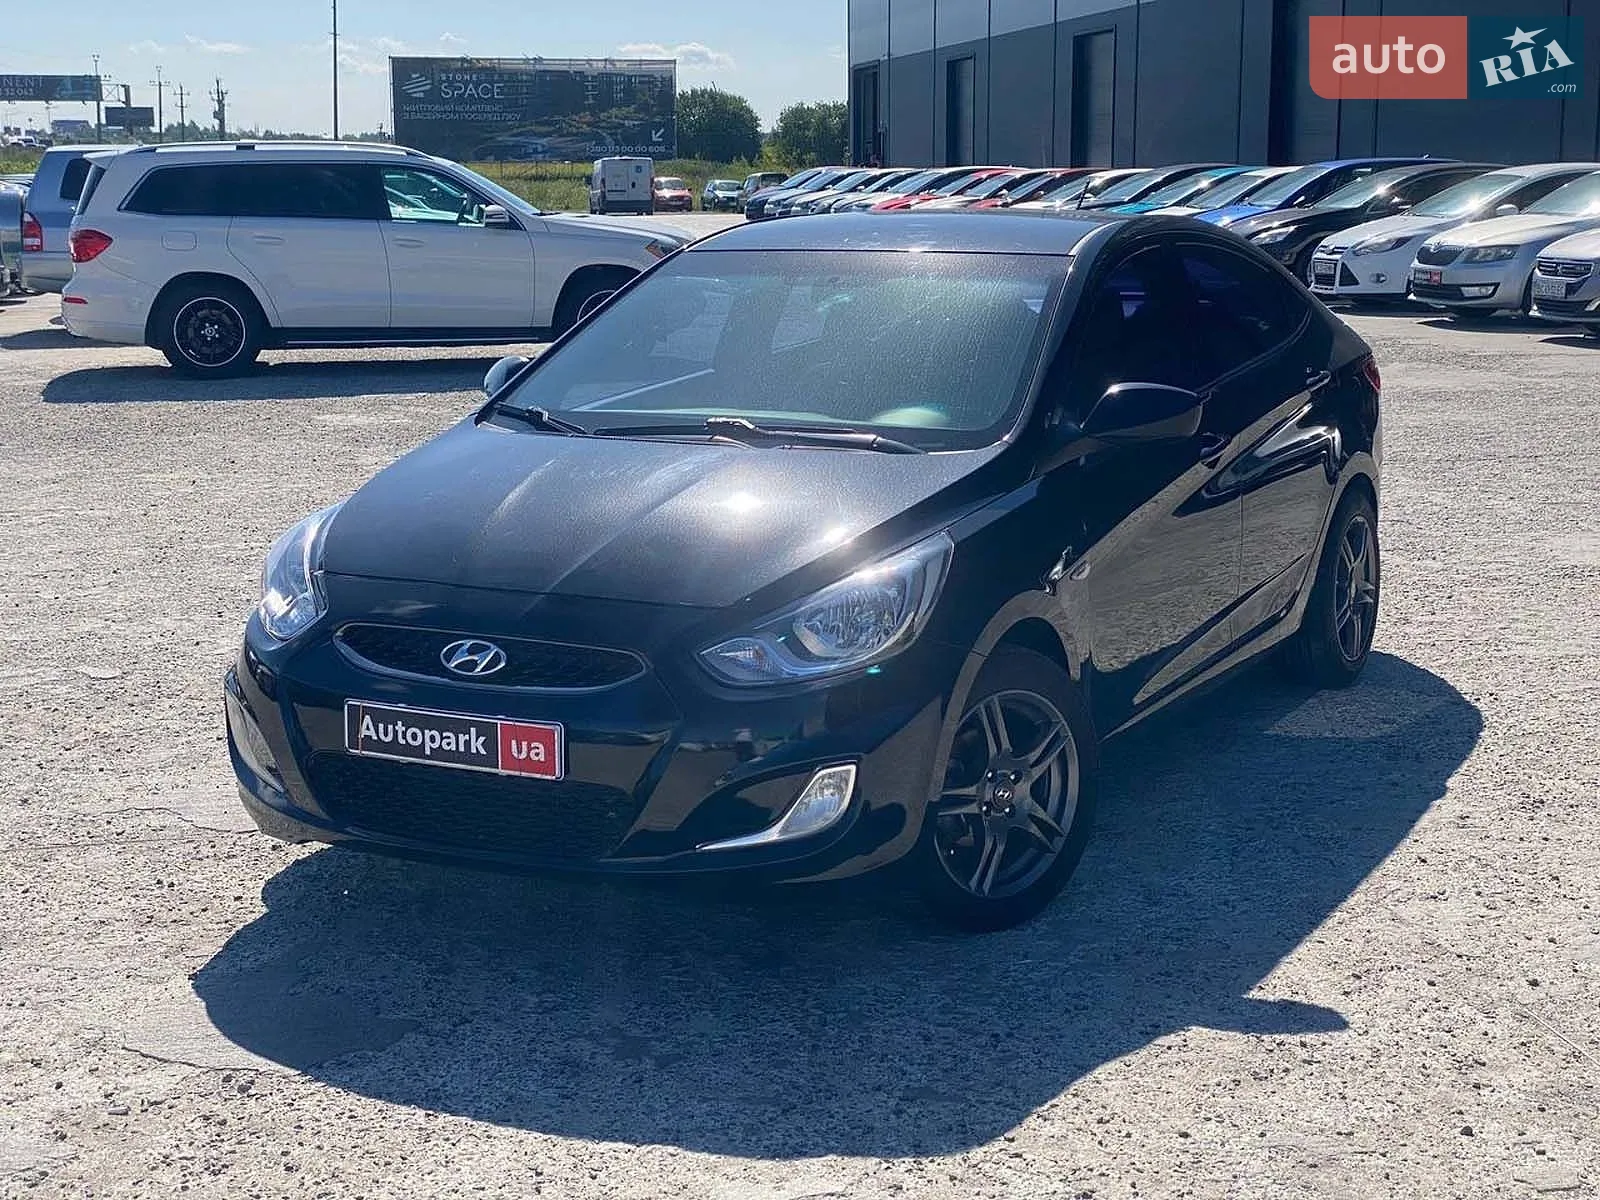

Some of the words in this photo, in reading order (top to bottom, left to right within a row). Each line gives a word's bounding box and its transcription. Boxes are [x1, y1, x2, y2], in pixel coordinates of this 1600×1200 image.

[440, 82, 505, 99] SPACE
[360, 714, 488, 756] Autopark
[511, 738, 546, 762] ua
